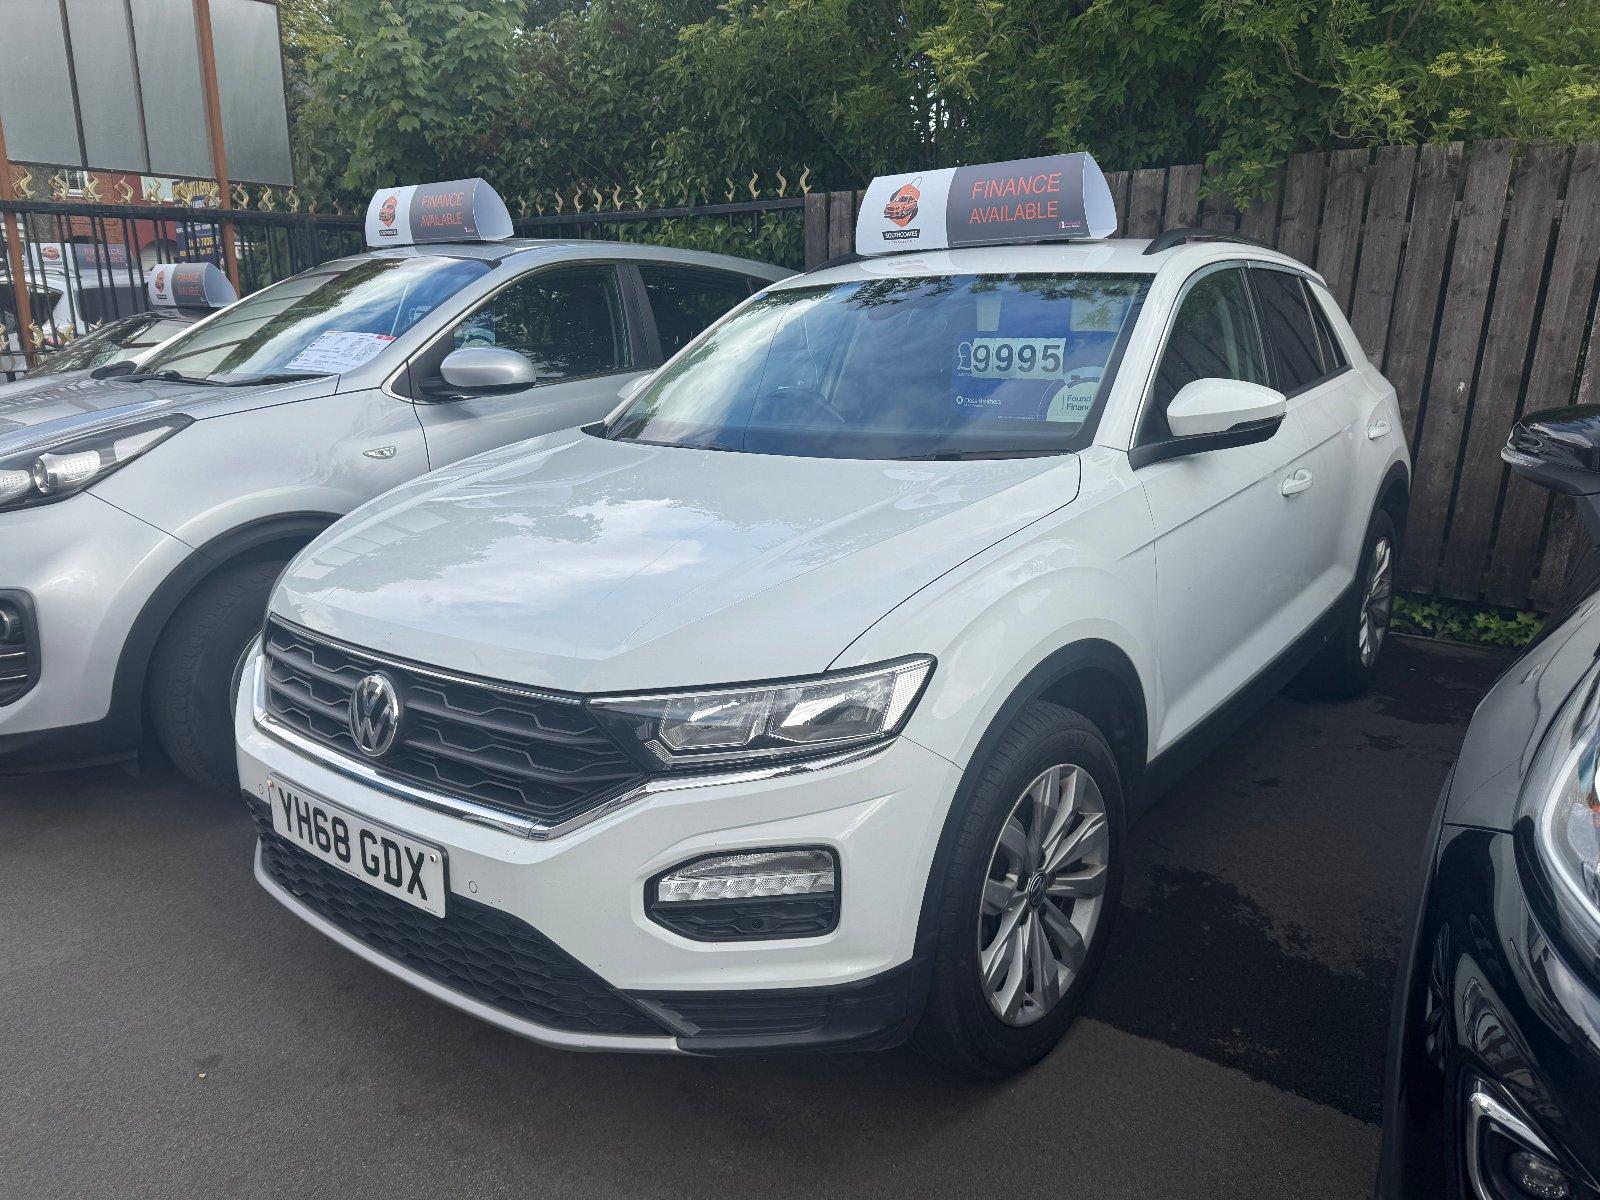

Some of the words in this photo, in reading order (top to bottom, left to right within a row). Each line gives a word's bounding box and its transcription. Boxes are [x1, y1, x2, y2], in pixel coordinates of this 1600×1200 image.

[971, 172, 1062, 200] FINANCE
[421, 192, 465, 208] FINANCE
[420, 212, 463, 228] AVAILABLE
[969, 201, 1058, 225] AVAILABLE
[1067, 394, 1092, 402] Found
[278, 787, 351, 864] YH68
[359, 828, 428, 901] GDX
